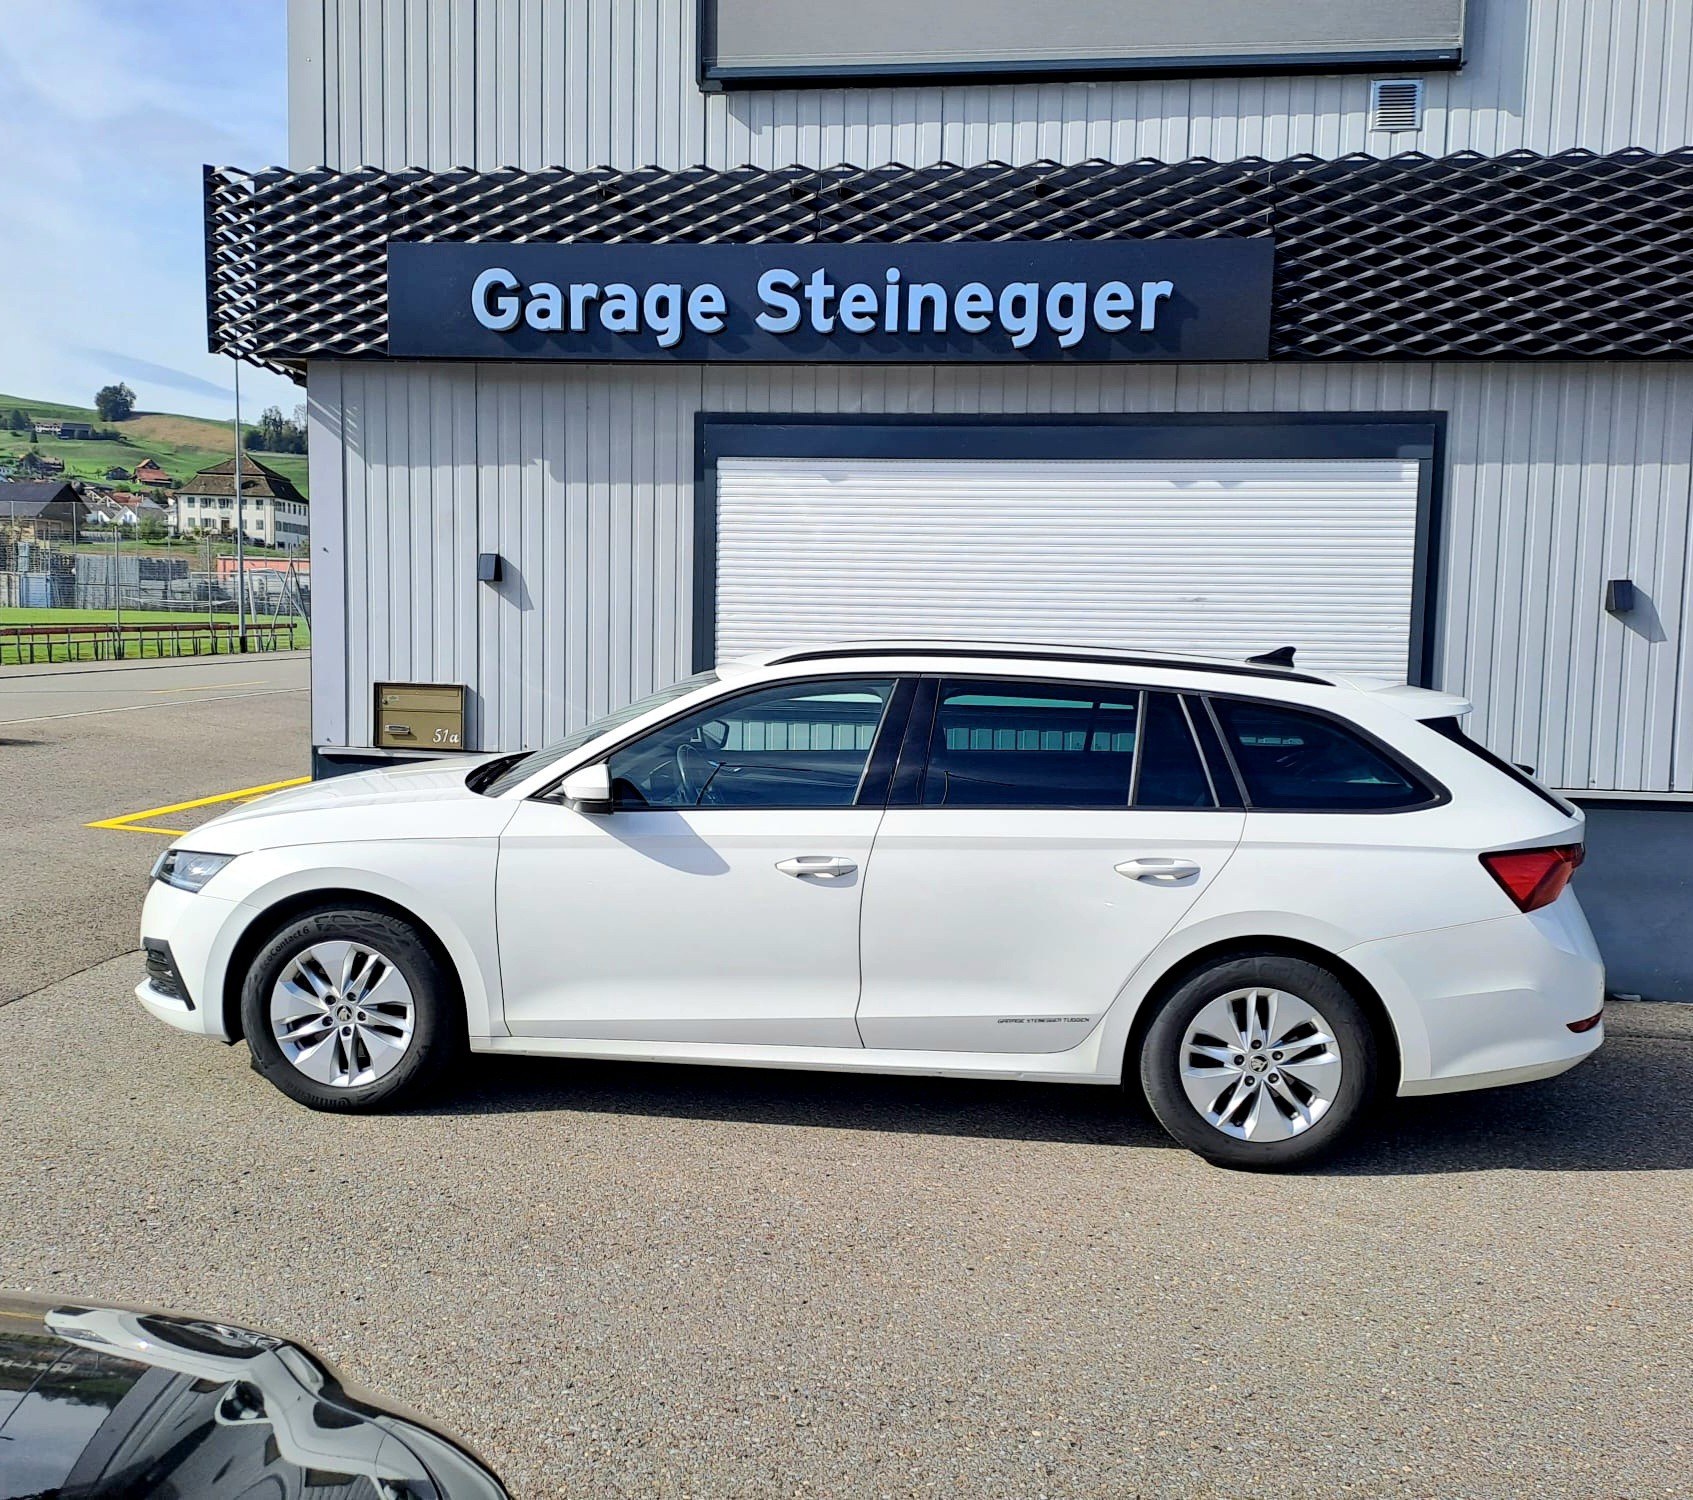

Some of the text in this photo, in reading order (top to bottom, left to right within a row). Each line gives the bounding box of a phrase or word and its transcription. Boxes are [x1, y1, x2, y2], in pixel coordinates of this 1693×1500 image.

[471, 267, 1175, 349] Garage Steinegger
[432, 728, 460, 744] 51a
